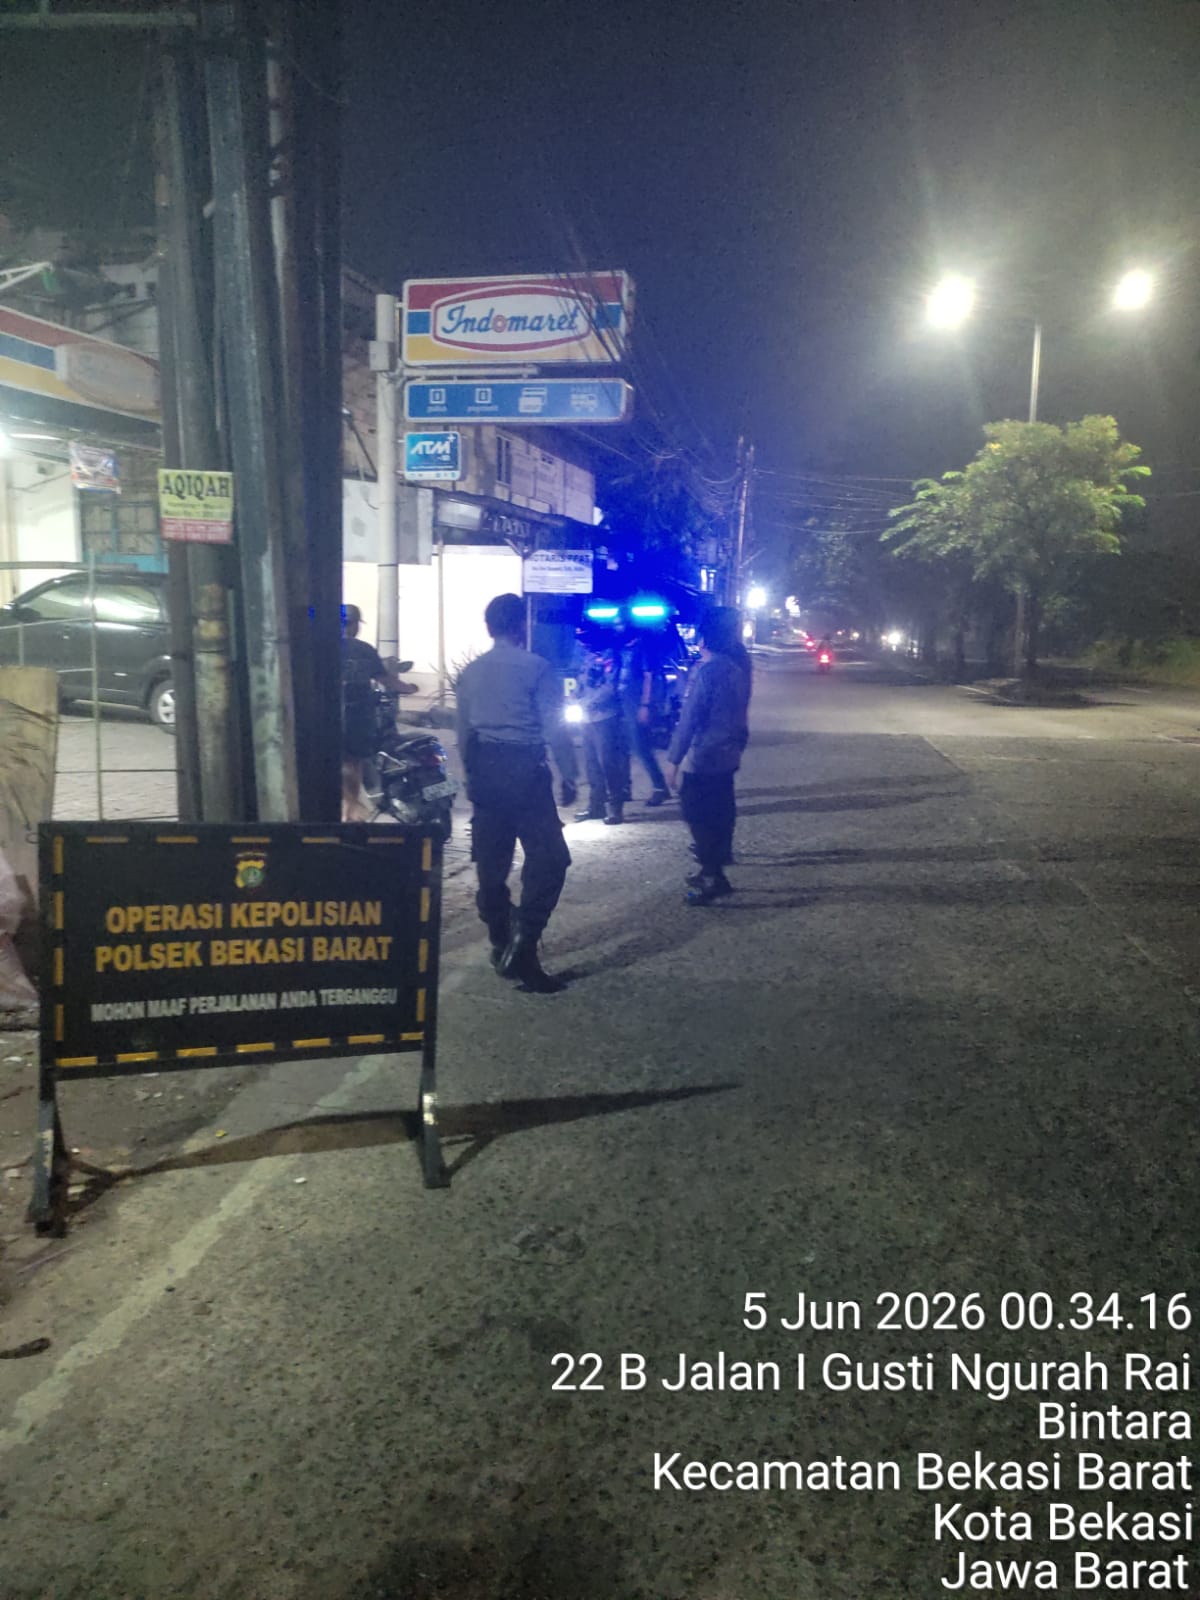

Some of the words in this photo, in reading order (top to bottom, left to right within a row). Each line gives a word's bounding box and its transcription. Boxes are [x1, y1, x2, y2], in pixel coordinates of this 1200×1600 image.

[441, 304, 580, 335] Indomaret
[410, 440, 450, 455] ATM
[162, 474, 230, 501] AQIQAH
[106, 903, 223, 934] OPERASI
[230, 901, 382, 928] KEPOLISIAN
[95, 941, 203, 973] POLSEK
[210, 937, 305, 966] BEKASI
[312, 936, 393, 961] BARAT
[91, 1001, 146, 1022] MOHON
[147, 998, 188, 1018] MAAF
[189, 992, 278, 1015] PERJALANAN
[279, 990, 318, 1009] ANDA
[319, 988, 398, 1006] TERGANGGU
